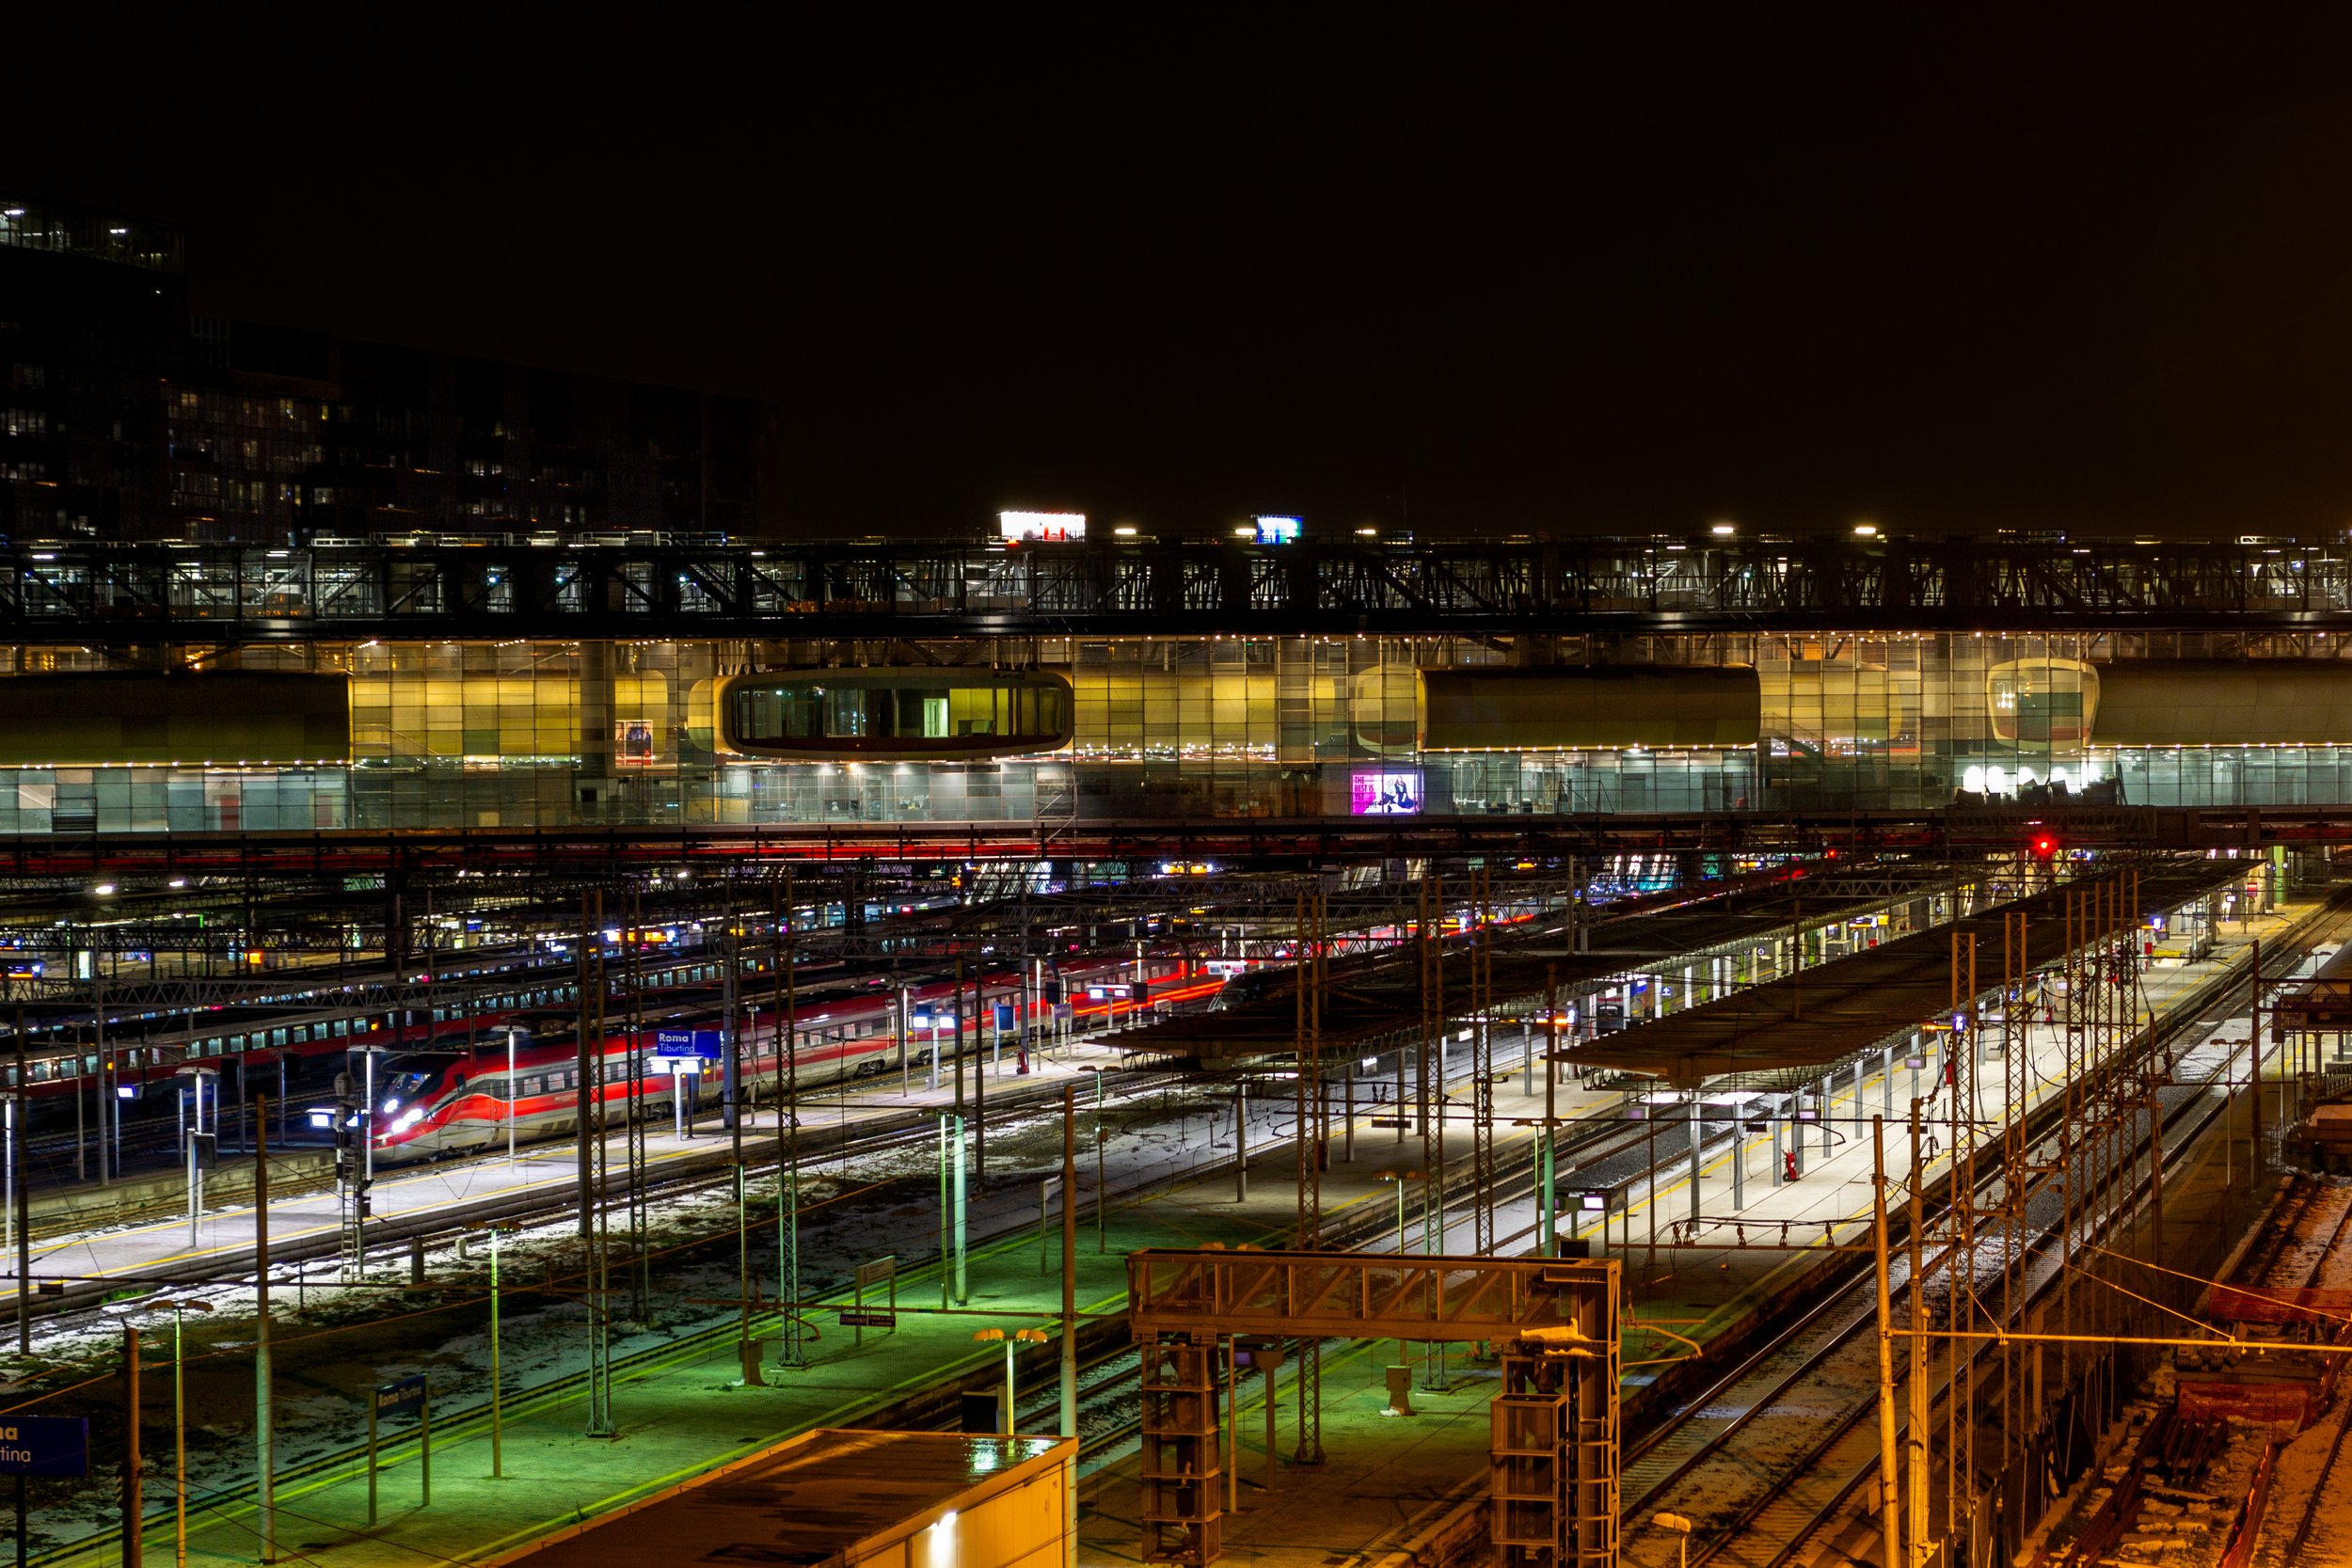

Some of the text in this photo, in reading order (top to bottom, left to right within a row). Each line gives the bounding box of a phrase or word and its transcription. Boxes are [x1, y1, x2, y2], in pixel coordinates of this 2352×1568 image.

[659, 1033, 689, 1043] Roma
[660, 1042, 694, 1053] Tiburtina
[377, 1386, 421, 1408] Roma Tiburtina
